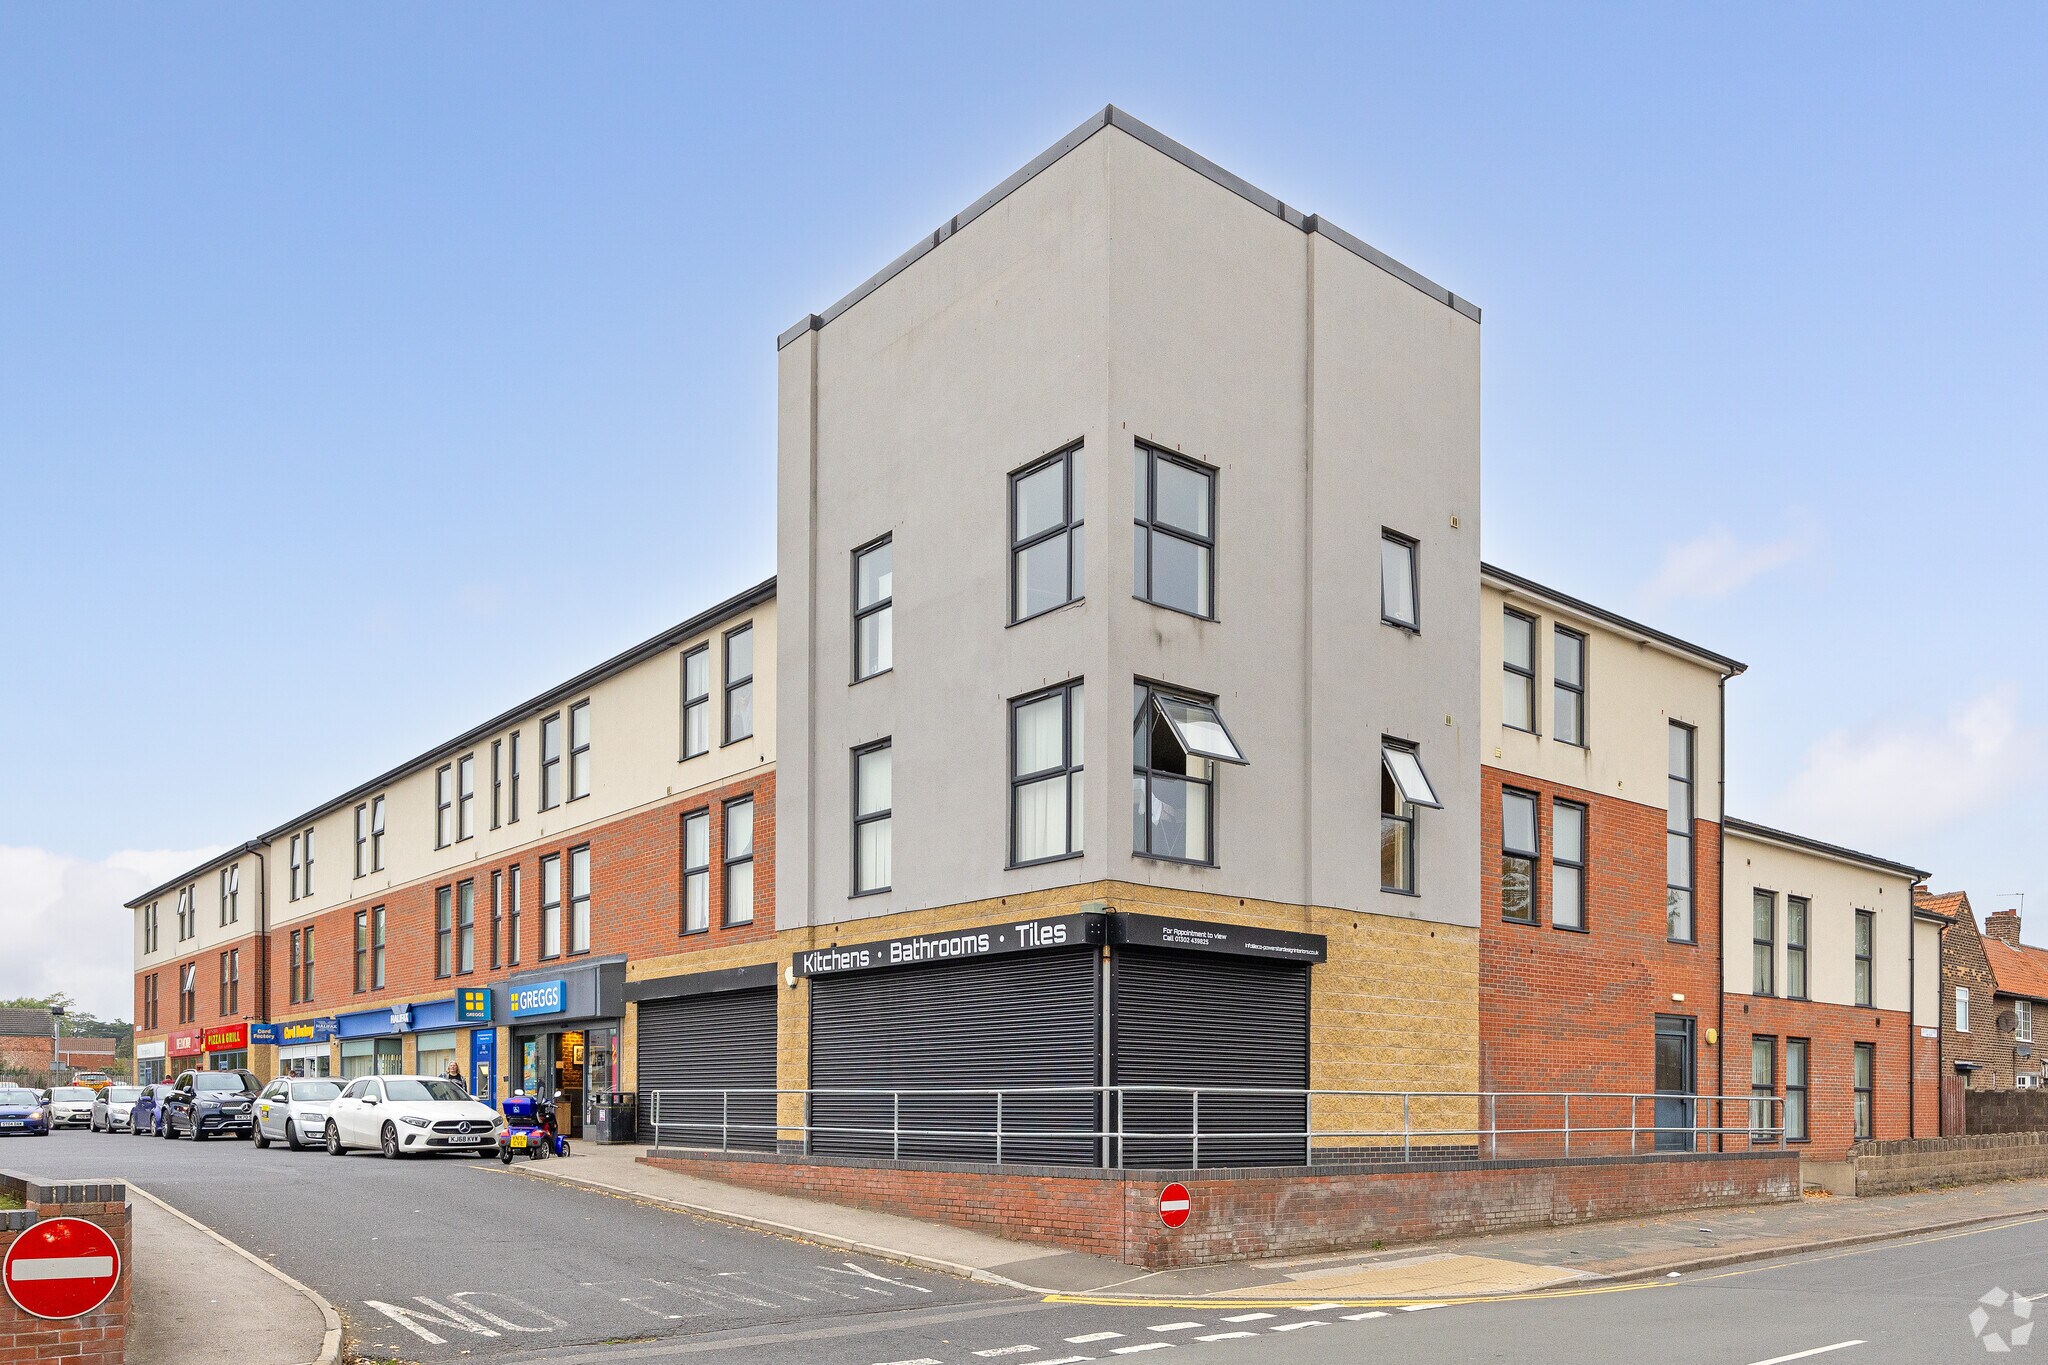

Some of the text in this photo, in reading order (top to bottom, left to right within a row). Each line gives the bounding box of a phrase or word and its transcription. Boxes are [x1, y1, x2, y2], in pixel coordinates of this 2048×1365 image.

[1174, 928, 1207, 938] Appointment
[803, 922, 1066, 973] Kitchens Bathrooms Tiles
[520, 986, 558, 1010] GREGGS
[390, 1012, 409, 1024] HALIFAX
[208, 1032, 240, 1045] PIZZA & GRILL
[283, 1024, 314, 1039] Card Factory
[363, 1291, 568, 1345] NO
